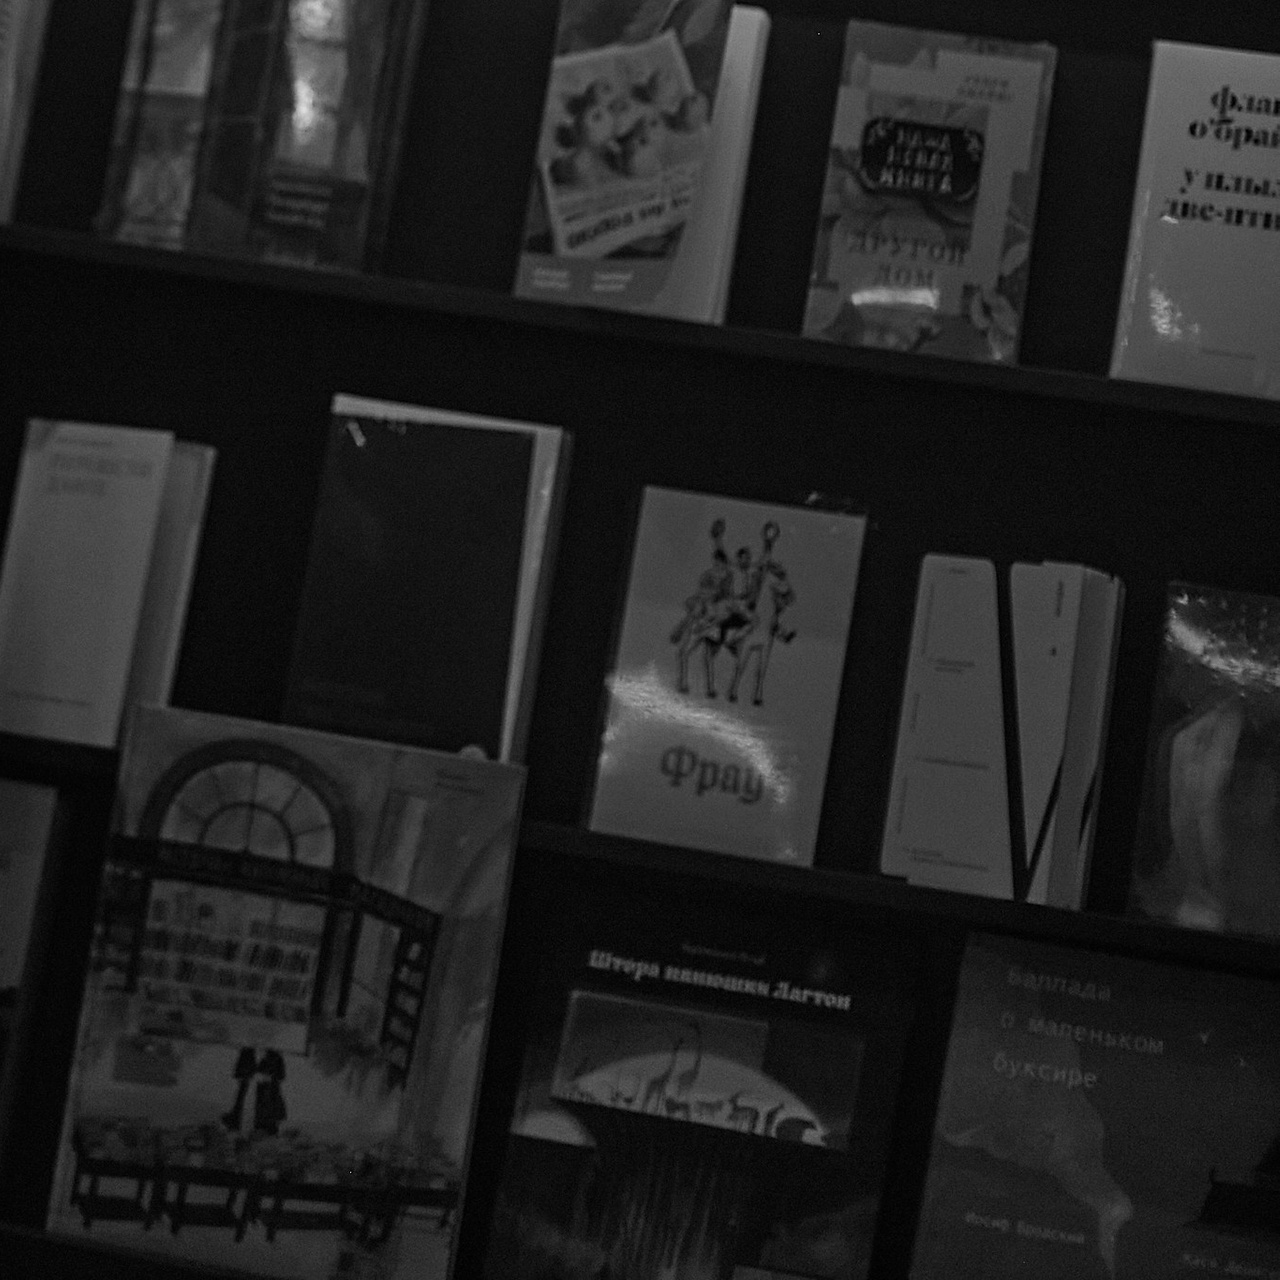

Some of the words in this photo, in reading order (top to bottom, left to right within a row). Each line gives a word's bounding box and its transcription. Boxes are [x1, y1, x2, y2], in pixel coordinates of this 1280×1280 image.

[660, 744, 764, 805] Фрау
[1027, 1014, 1166, 1056] маленьком
[992, 1049, 1098, 1091] буксире
